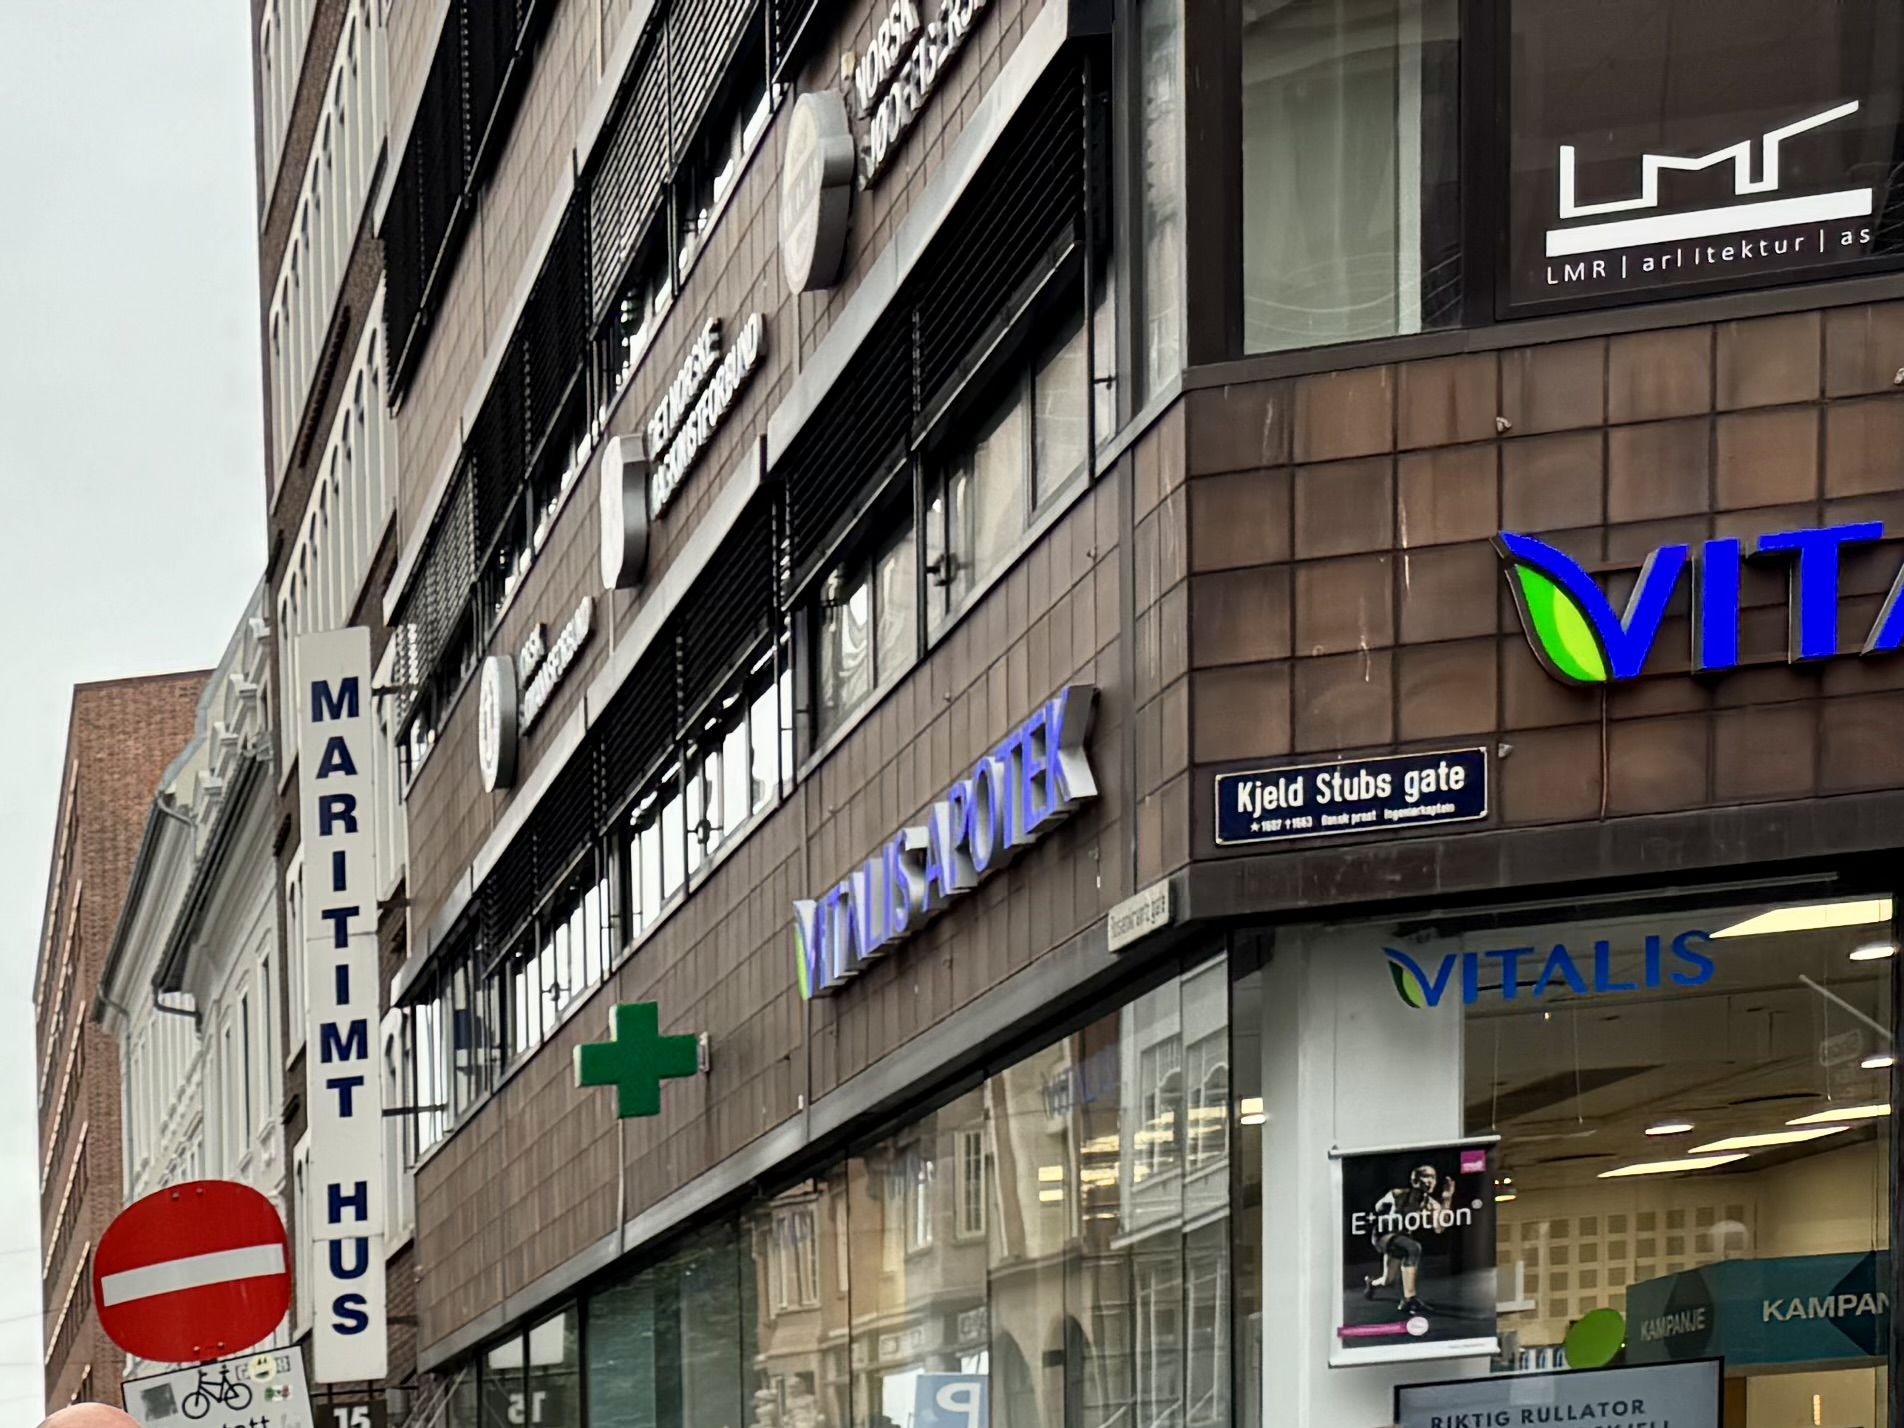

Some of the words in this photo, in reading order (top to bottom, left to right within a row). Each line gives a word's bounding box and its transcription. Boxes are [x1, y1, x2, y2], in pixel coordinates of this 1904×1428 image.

[1546, 259, 1607, 285] LMR
[1840, 226, 1872, 247] as
[1237, 776, 1304, 818] Kjeld
[1316, 769, 1392, 804] Stubs
[1404, 761, 1465, 803] gate
[311, 676, 368, 1119] MARITIMT
[1382, 930, 1717, 1009] VITALIS
[328, 1182, 369, 1337] HUS
[1641, 1307, 1707, 1342] KAMPANJE
[1521, 1400, 1646, 1425] RULLATOR
